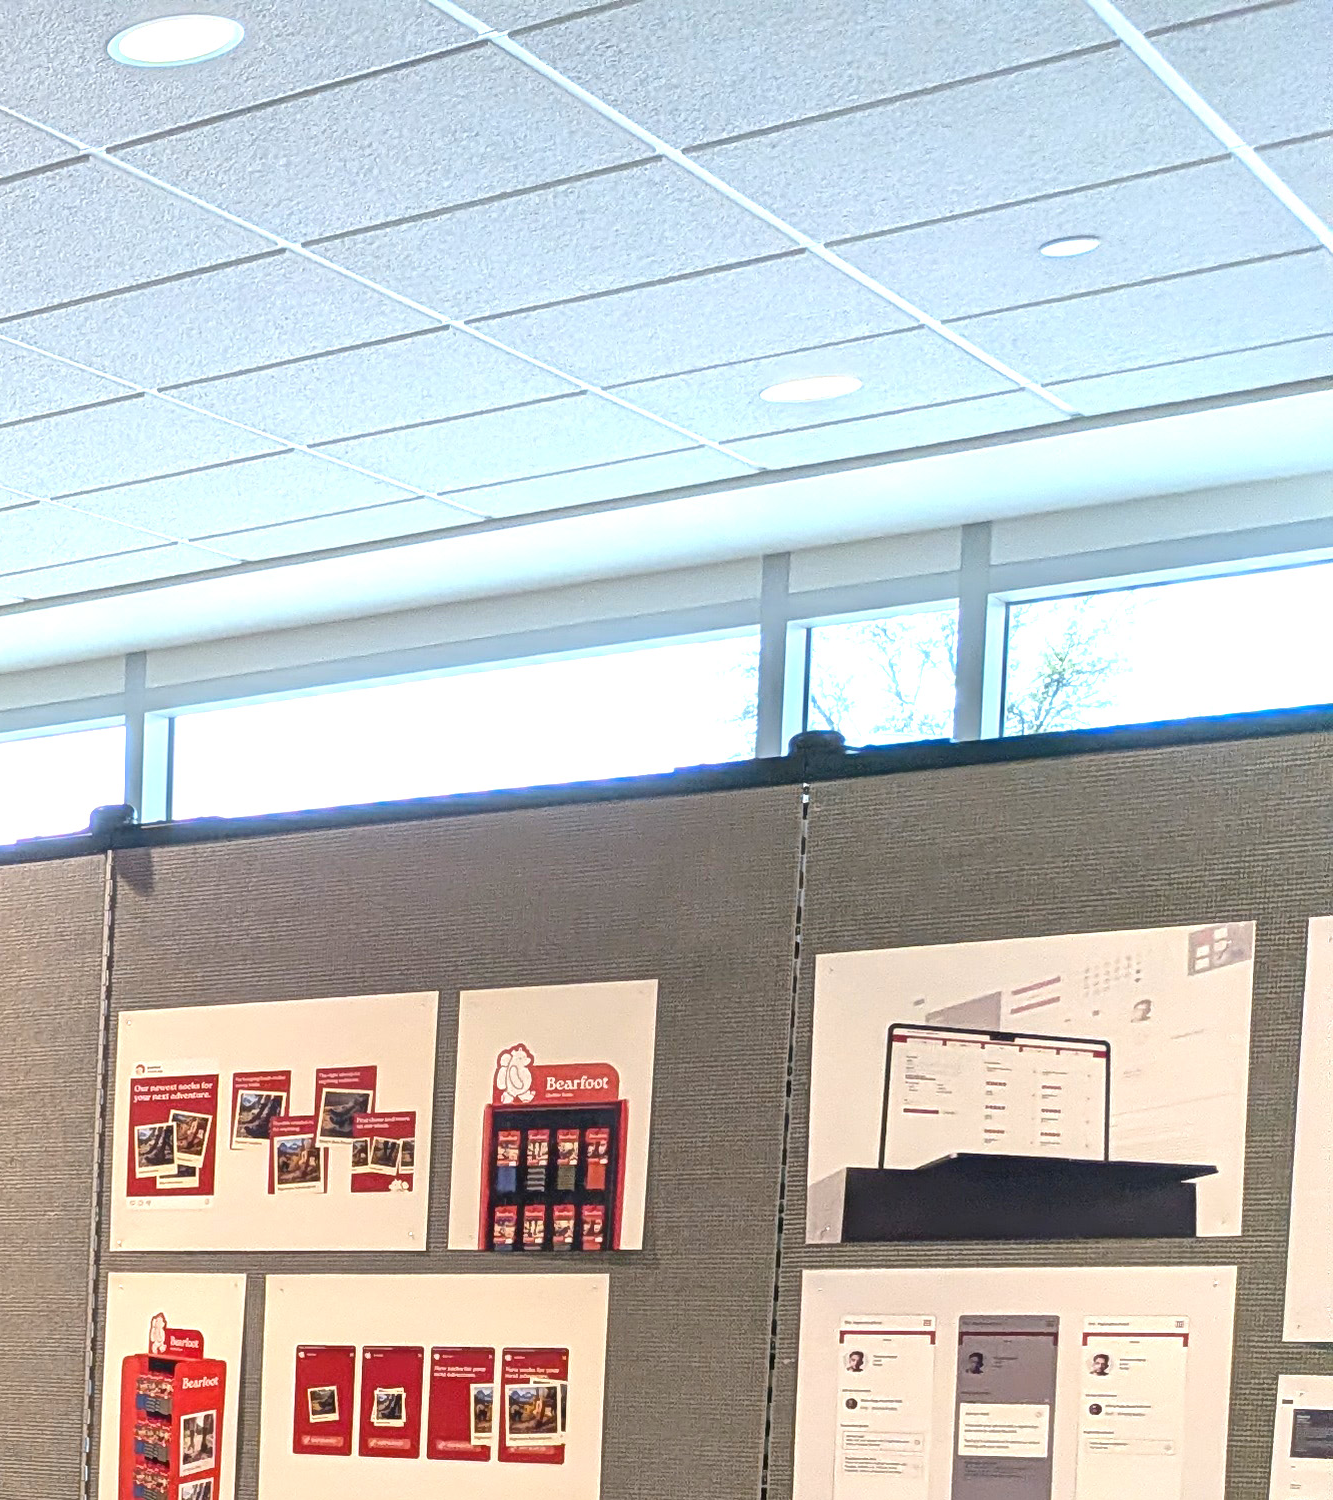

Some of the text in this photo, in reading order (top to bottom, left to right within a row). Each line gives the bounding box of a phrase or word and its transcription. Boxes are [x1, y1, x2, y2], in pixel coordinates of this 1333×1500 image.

[545, 1075, 609, 1091] Bearfoot
[170, 1335, 200, 1349] Bearfoot
[182, 1376, 219, 1390] Bearfoot
